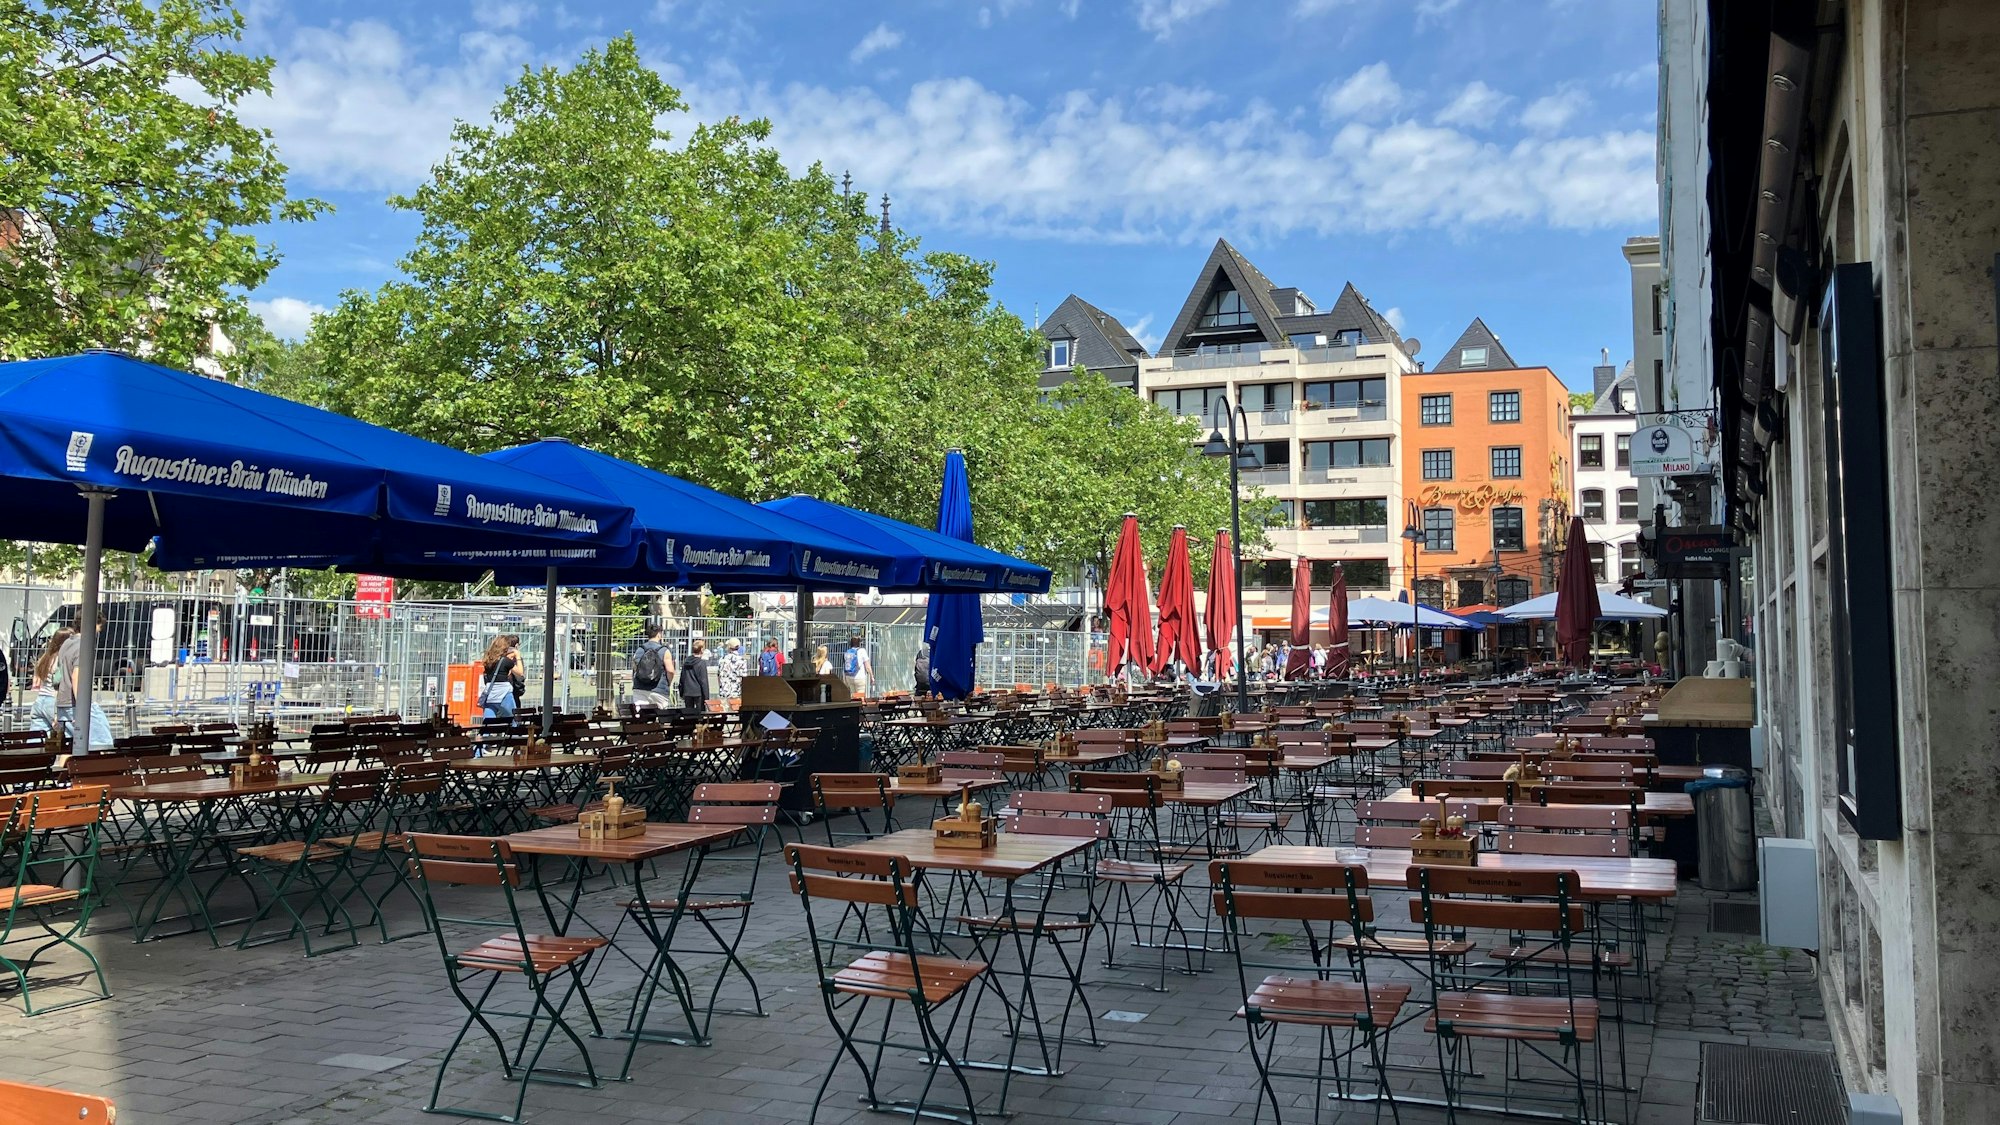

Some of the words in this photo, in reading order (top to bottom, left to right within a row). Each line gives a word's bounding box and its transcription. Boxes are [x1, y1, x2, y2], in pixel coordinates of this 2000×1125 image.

[1663, 463, 1690, 472] MILANO
[265, 467, 328, 499] München
[558, 509, 599, 534] München
